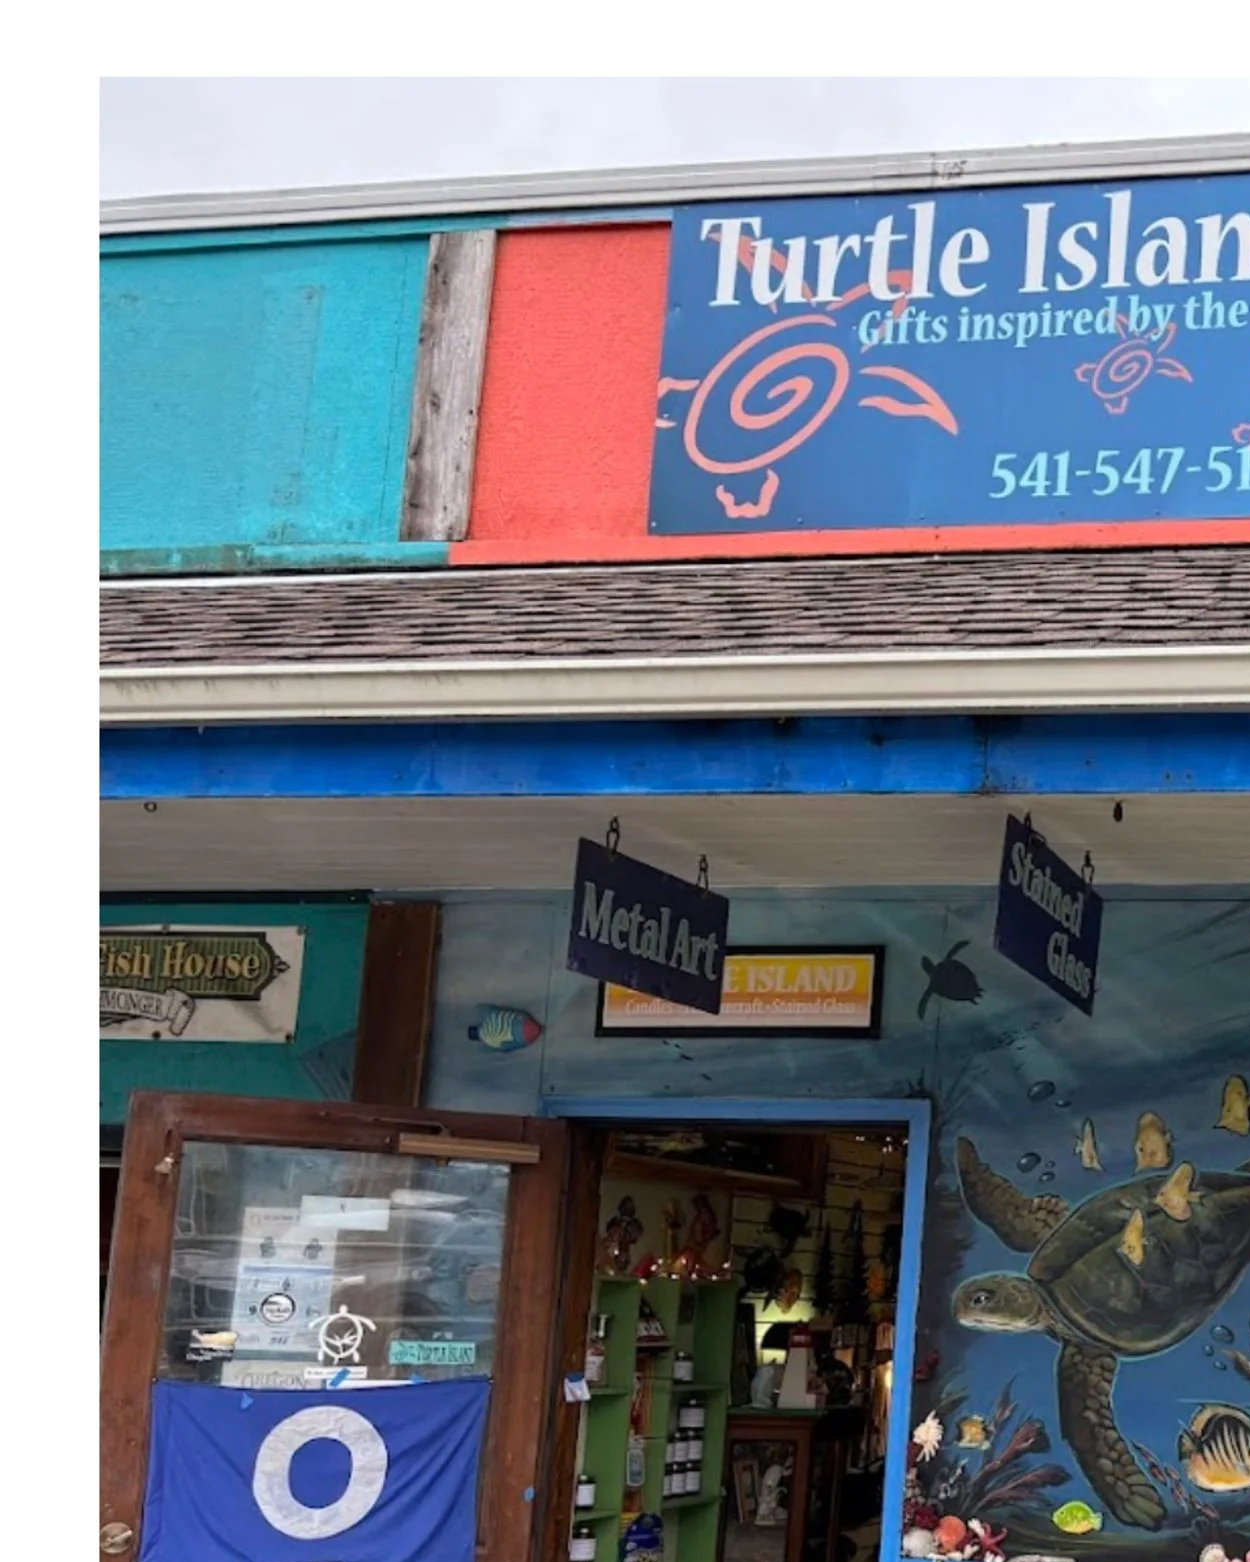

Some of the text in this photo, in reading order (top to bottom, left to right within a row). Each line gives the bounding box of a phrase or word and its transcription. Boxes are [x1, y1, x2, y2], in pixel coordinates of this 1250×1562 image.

[700, 200, 990, 307] Turtle
[857, 308, 948, 346] Gifts
[957, 296, 1117, 348] inspired
[1128, 299, 1175, 341] by
[1184, 291, 1249, 331] the
[1008, 841, 1083, 939] Stained
[160, 941, 260, 980] House
[578, 880, 719, 982] Metal Art
[747, 965, 857, 994] ISLAND
[1047, 931, 1093, 998] Glass
[100, 989, 163, 1016] MONGER
